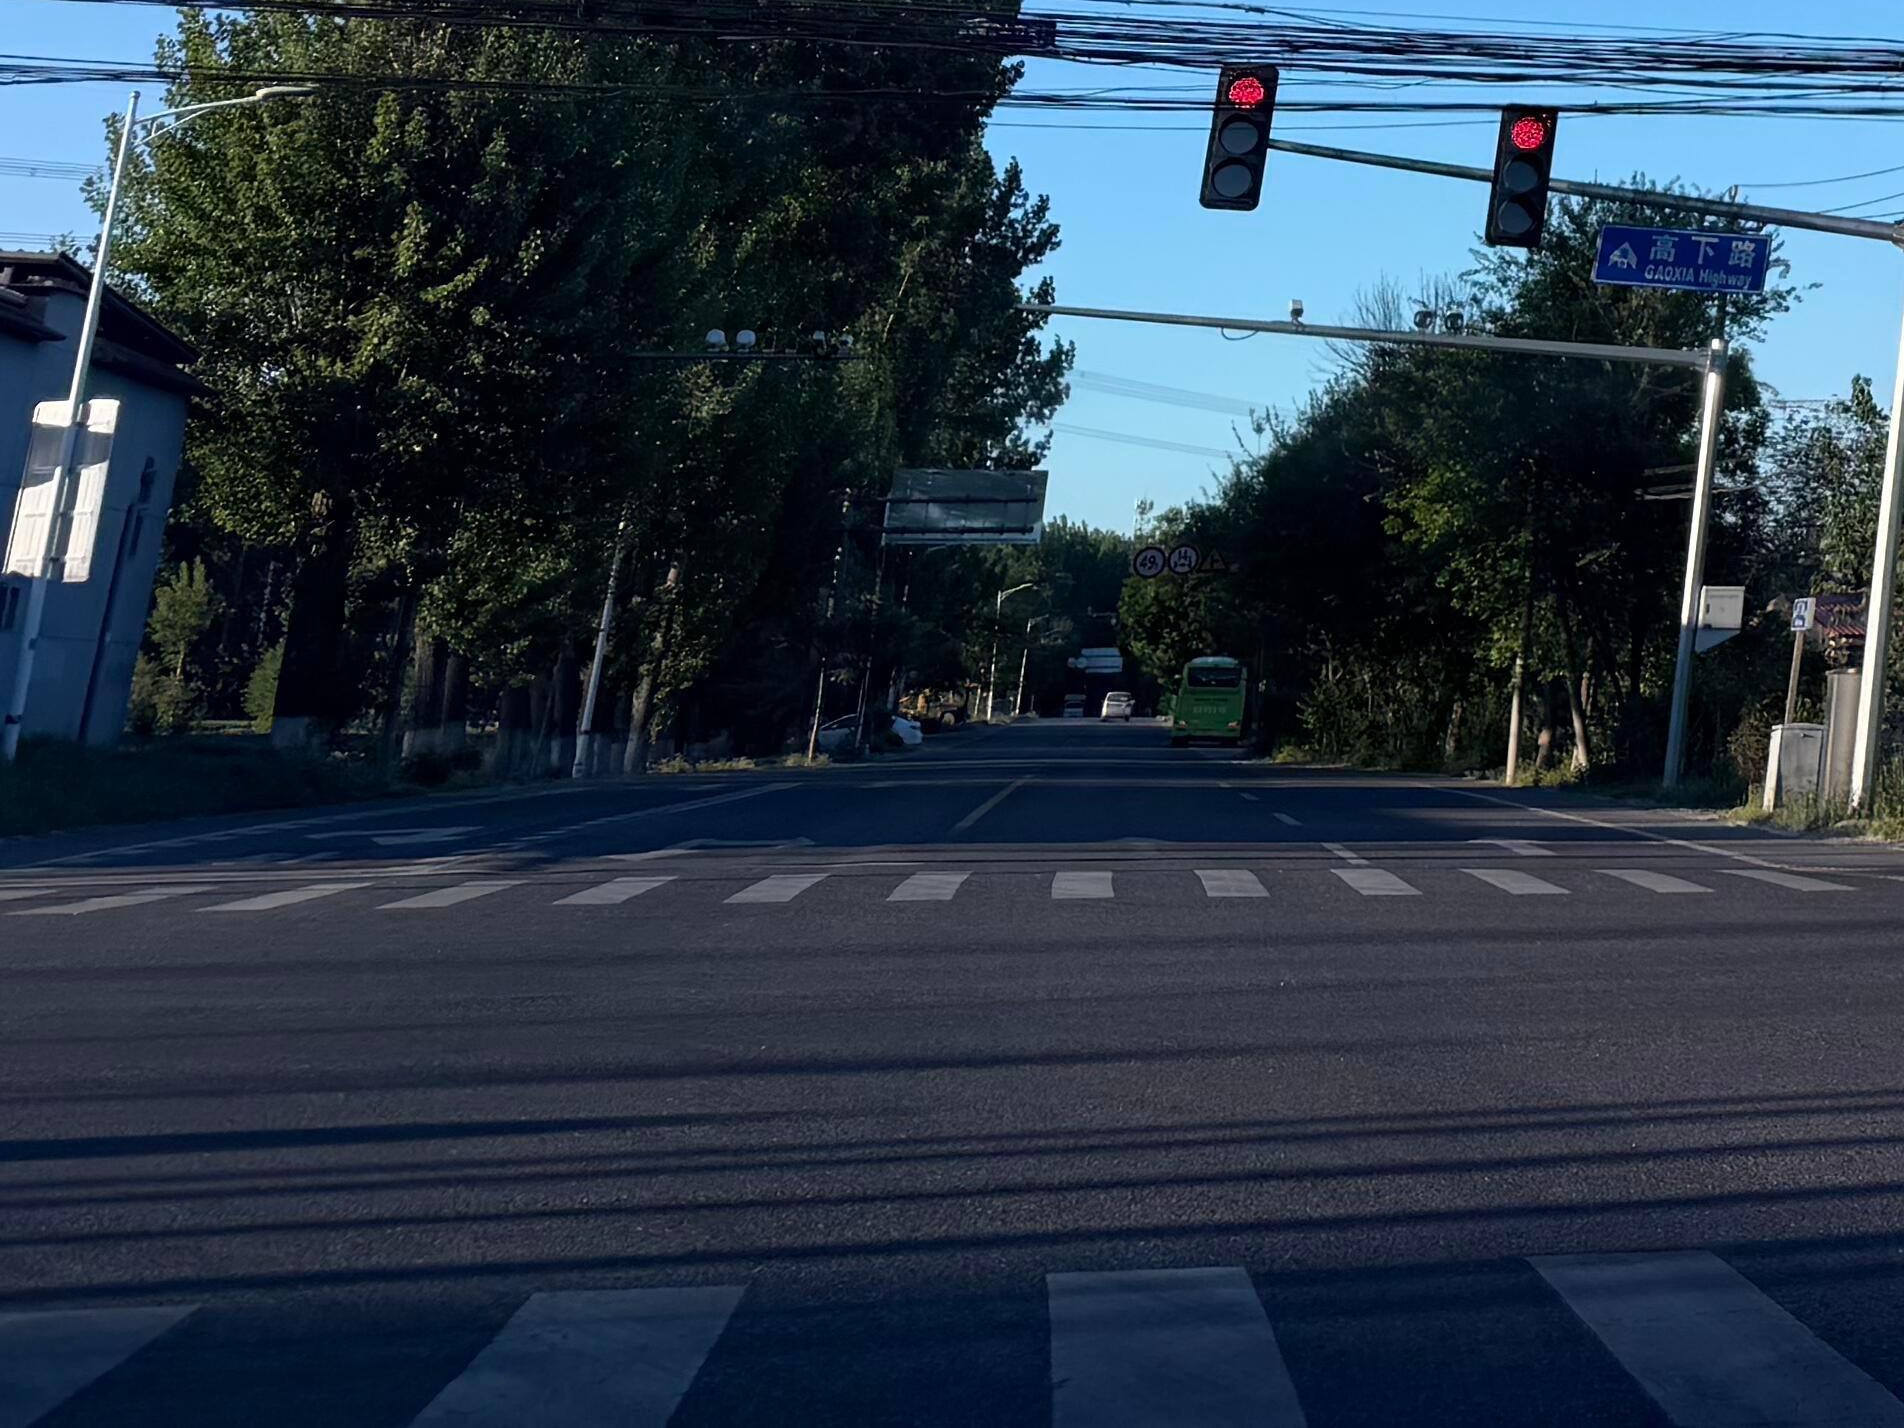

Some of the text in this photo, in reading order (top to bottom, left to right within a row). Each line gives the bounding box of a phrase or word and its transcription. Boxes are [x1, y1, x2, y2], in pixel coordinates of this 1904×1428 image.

[1649, 234, 1756, 268] 高下路
[1644, 264, 1752, 289] GAOXIA Highway
